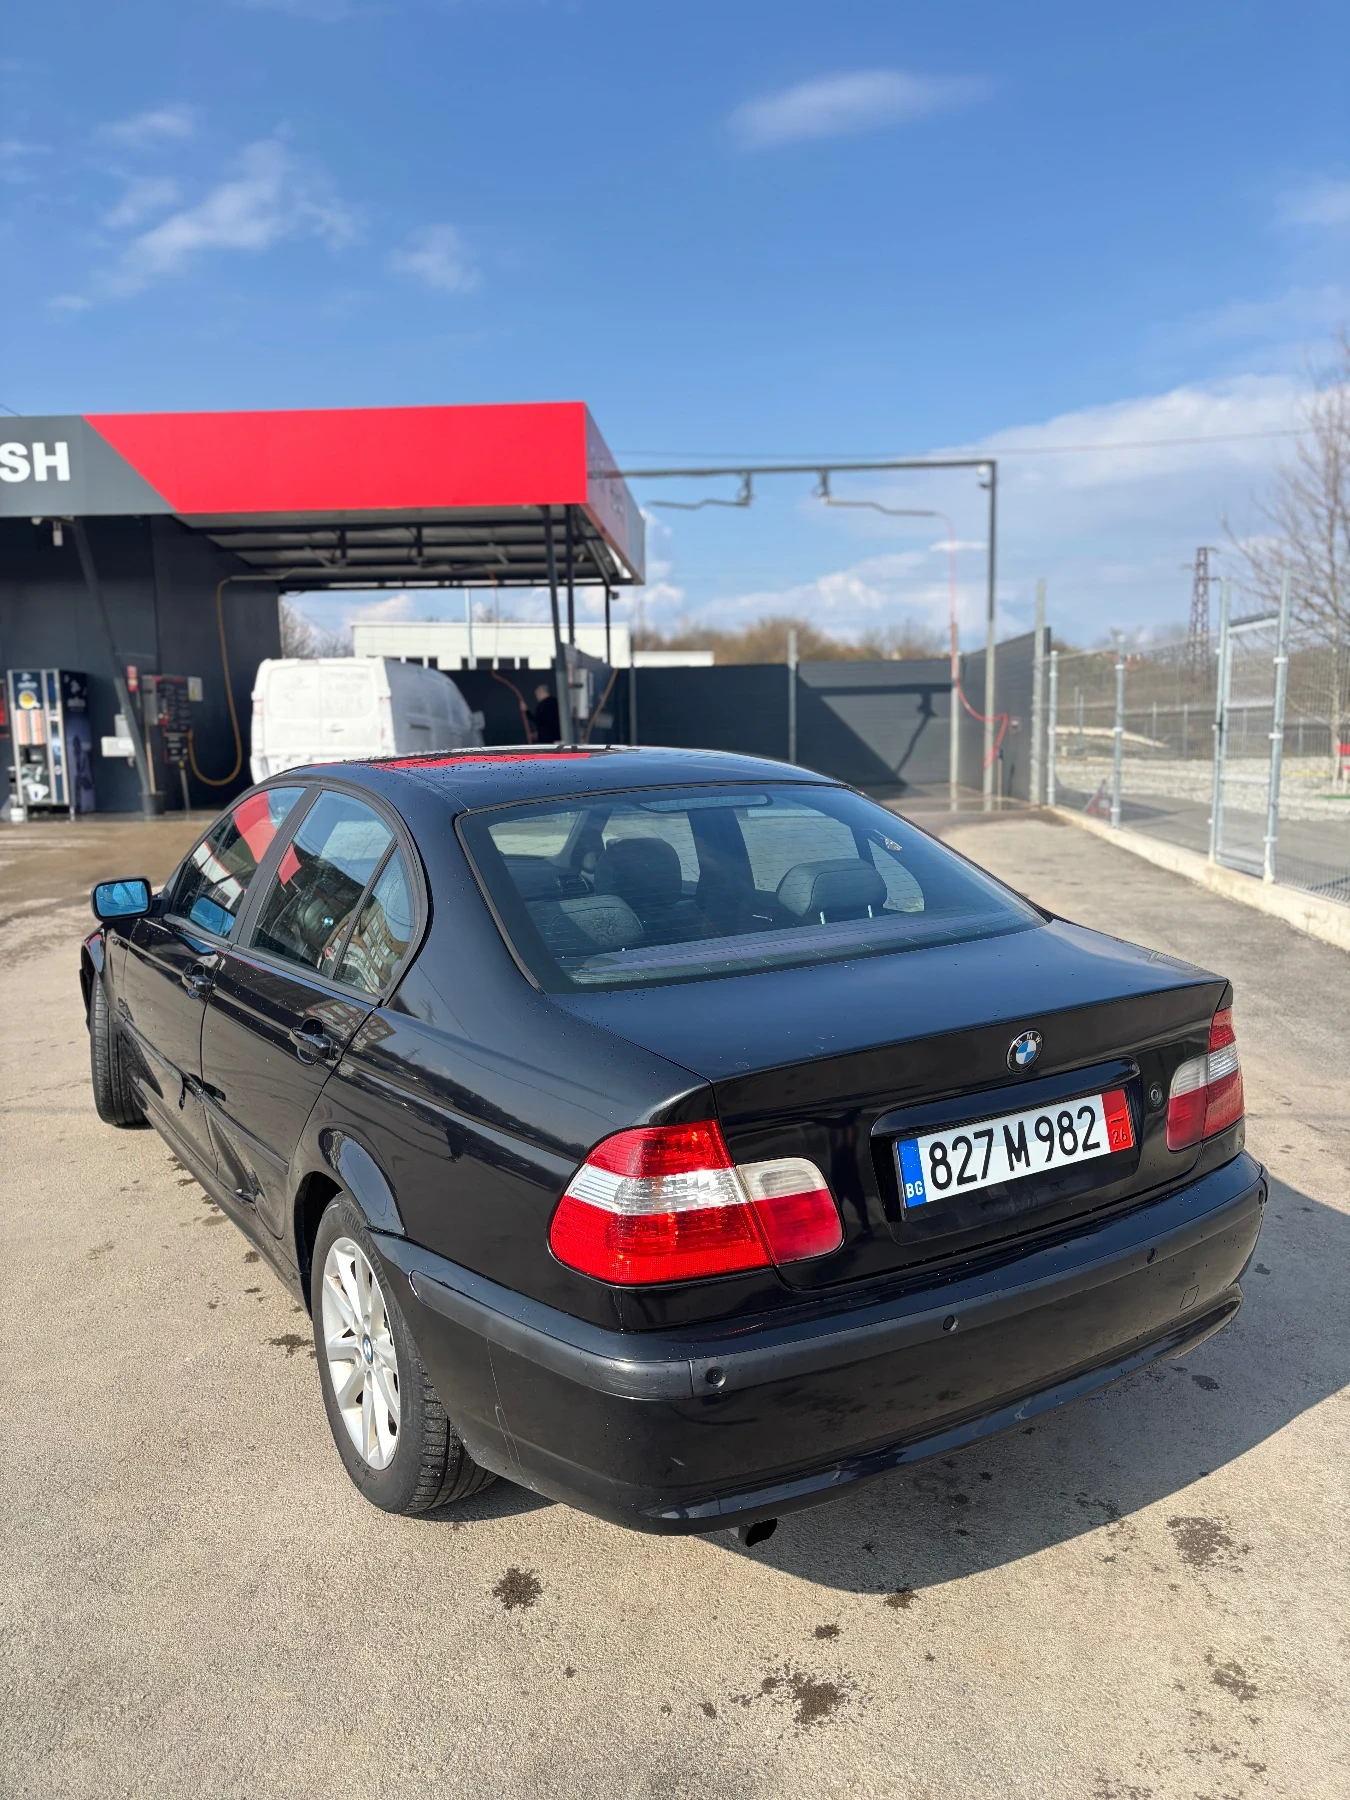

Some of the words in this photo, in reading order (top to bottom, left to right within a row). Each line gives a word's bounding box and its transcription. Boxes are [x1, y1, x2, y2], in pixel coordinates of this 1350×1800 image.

[0, 442, 70, 483] SH
[1014, 1032, 1041, 1047] BMW
[1112, 1128, 1127, 1145] 26
[929, 1128, 994, 1190] 827
[1003, 1121, 1031, 1172] M
[1034, 1105, 1101, 1163] 982
[905, 1180, 924, 1198] BG
